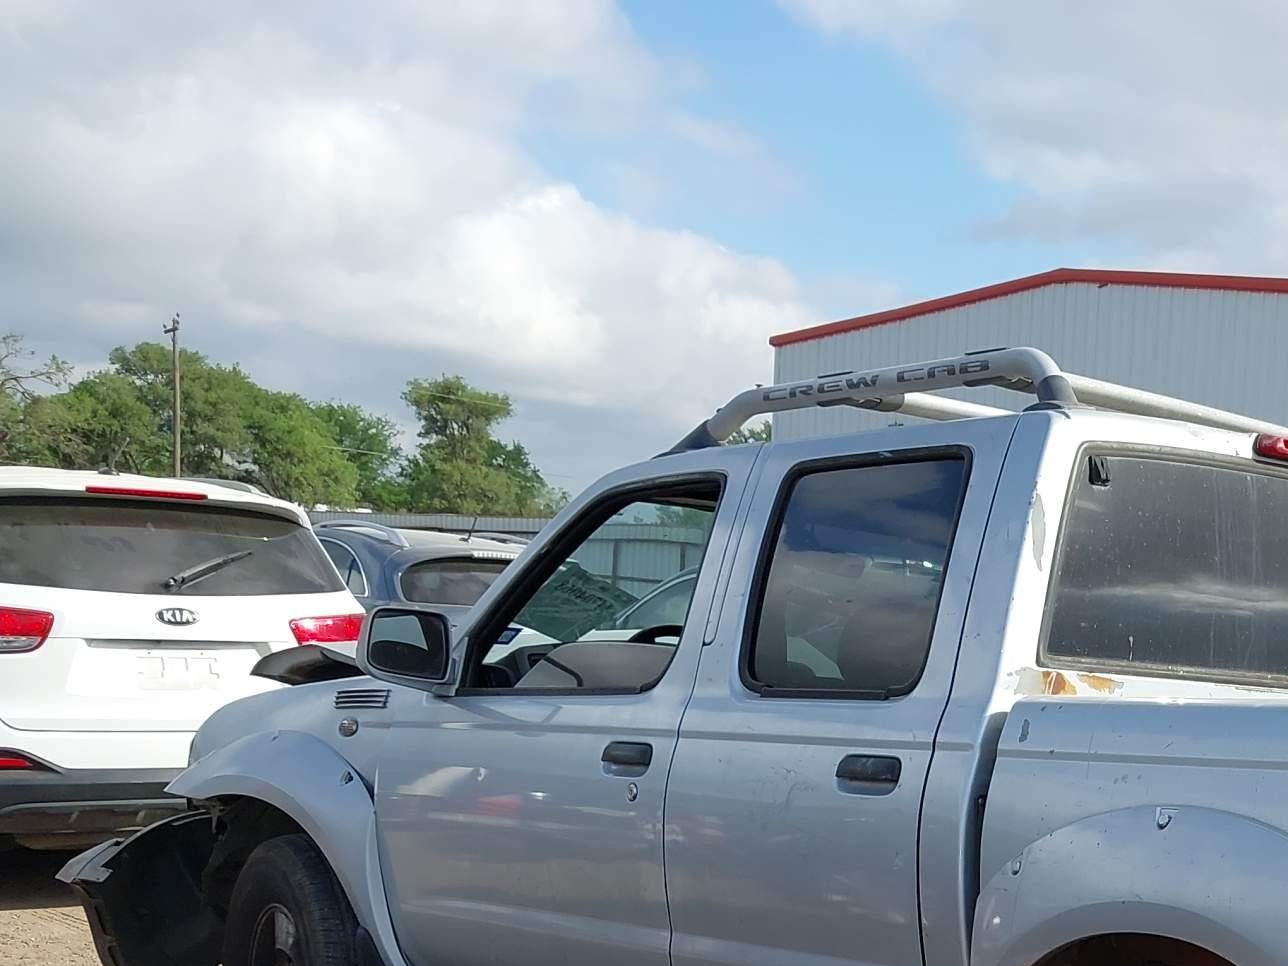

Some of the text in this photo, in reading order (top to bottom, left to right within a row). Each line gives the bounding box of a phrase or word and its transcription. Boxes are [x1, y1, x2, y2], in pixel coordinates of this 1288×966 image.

[763, 359, 990, 400] CREW CAB
[161, 609, 195, 622] KIA
